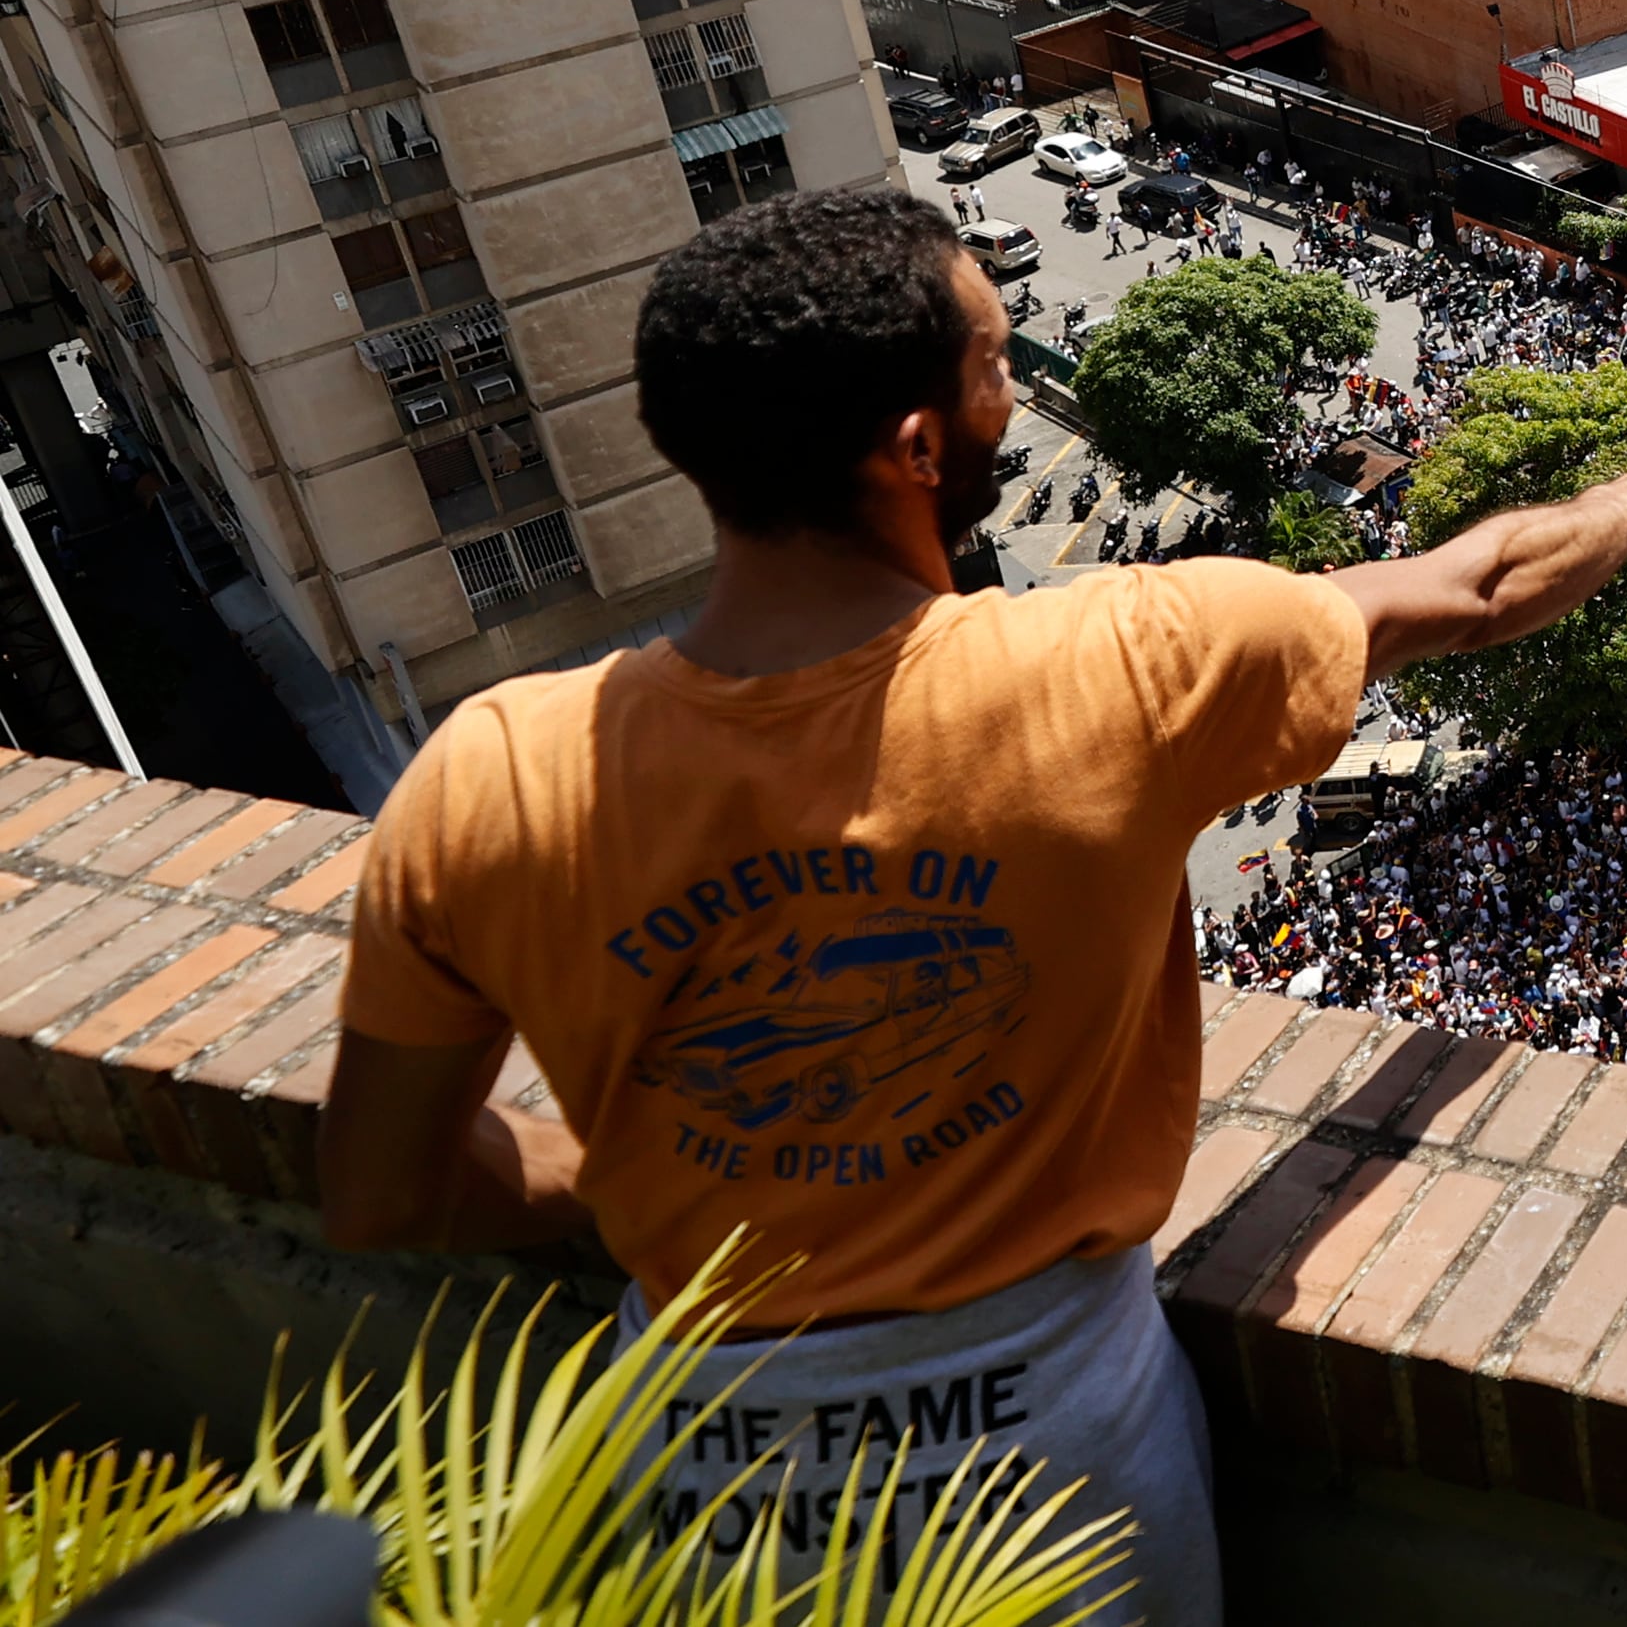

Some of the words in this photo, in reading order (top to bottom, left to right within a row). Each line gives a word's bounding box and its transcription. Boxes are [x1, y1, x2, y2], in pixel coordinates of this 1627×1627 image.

[1522, 84, 1540, 112] EL
[1541, 93, 1601, 139] CASTILLO
[606, 846, 879, 978] FOREVER
[908, 849, 999, 908] ON
[673, 1122, 752, 1180] THE
[772, 1143, 887, 1186] OPEN
[902, 1080, 1025, 1167] ROAD
[664, 1398, 783, 1466] THE
[815, 1362, 1029, 1463] FAME
